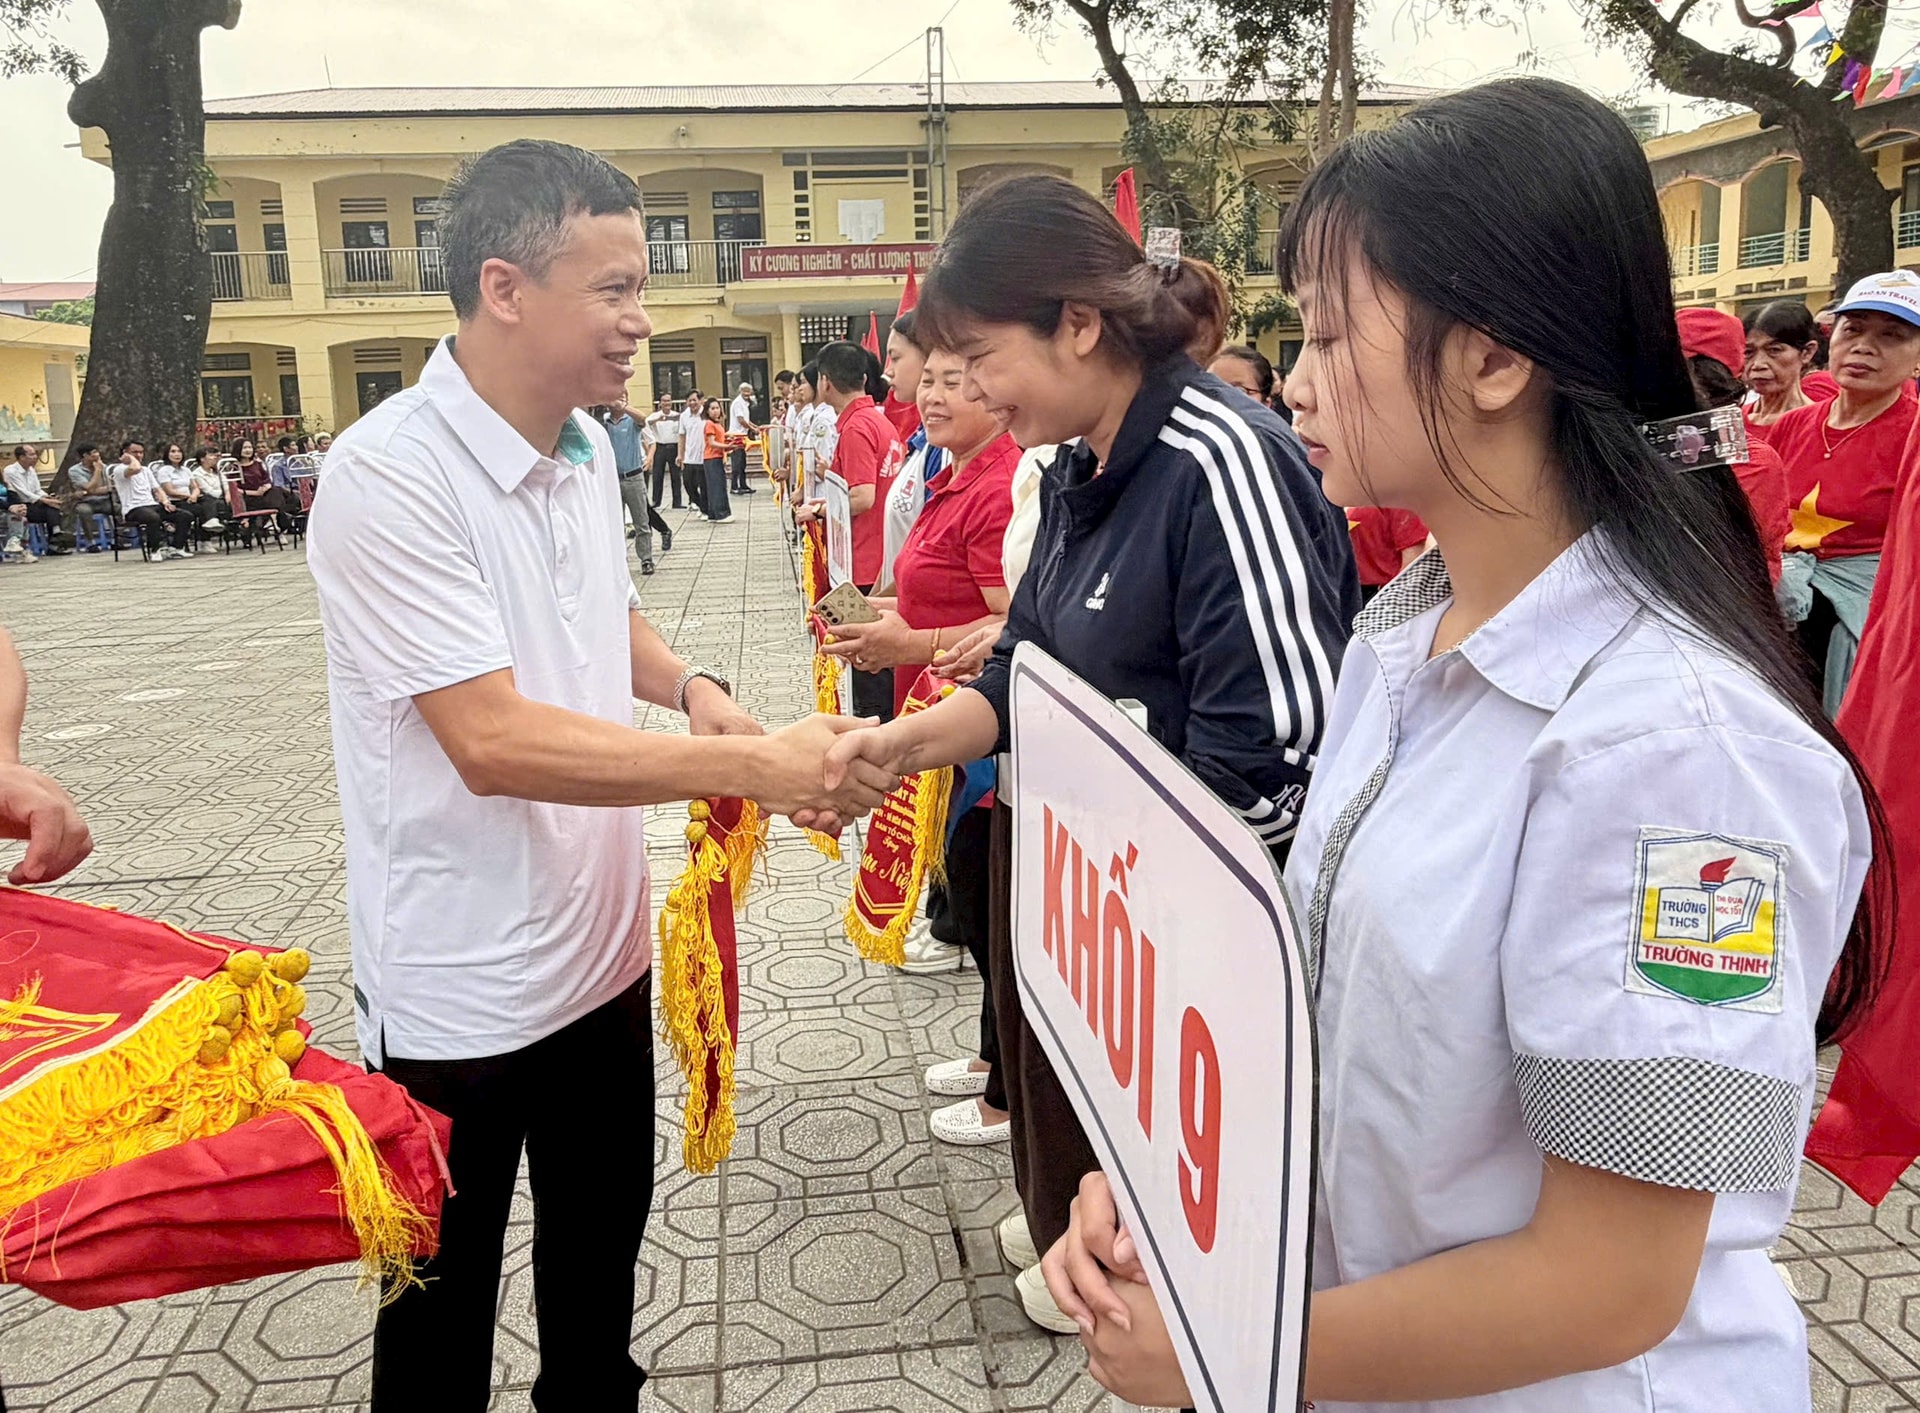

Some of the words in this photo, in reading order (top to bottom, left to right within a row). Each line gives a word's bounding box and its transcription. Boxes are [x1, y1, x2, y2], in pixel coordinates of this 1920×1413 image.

[1661, 898, 1707, 915] TRƯỜNG
[1669, 916, 1699, 929] THCS
[1642, 945, 1714, 969] TRƯỜNG
[1720, 955, 1769, 974] THỊNH
[1043, 803, 1155, 1144] KHỐI
[1177, 1006, 1222, 1255] 9
